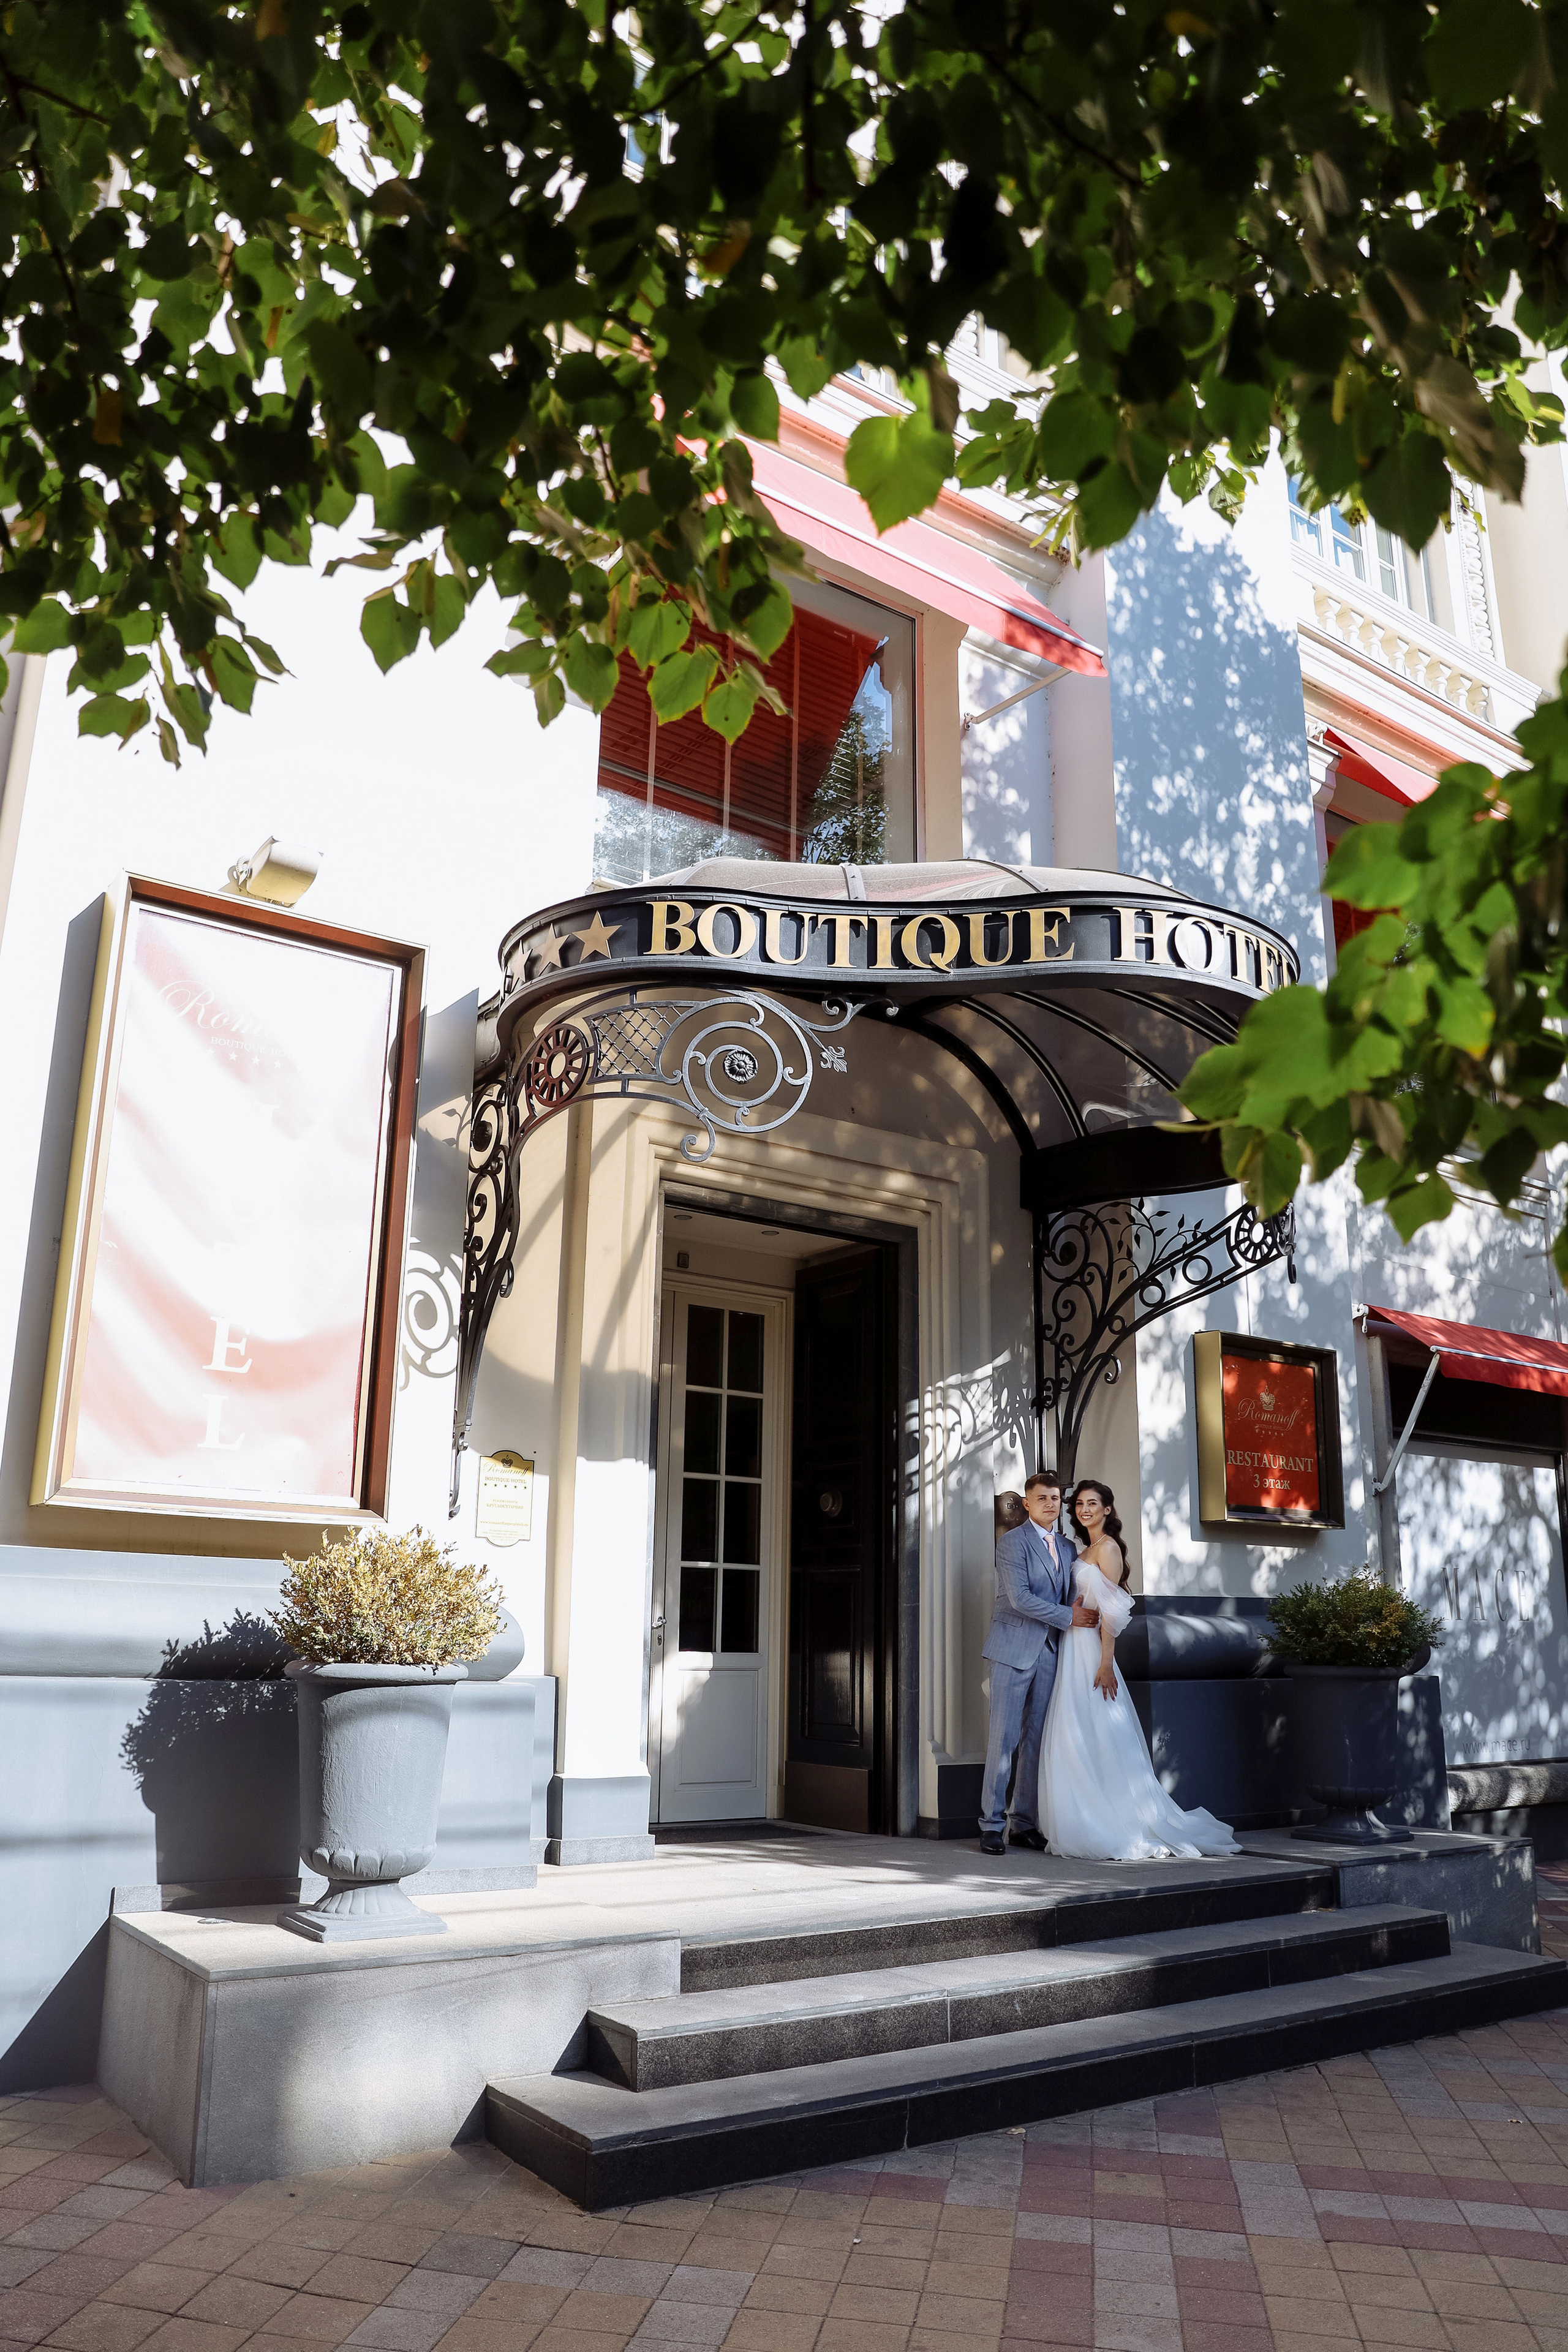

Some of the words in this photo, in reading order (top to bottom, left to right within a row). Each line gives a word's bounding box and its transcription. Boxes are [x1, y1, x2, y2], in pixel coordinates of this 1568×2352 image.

[644, 901, 1075, 974] BOUTIQUE
[211, 1036, 266, 1053] BOUTIQUE
[1238, 1398, 1300, 1431] Romanoff
[483, 1461, 531, 1478] Romanoff
[1227, 1450, 1314, 1472] RESTAURANT
[1253, 1474, 1261, 1488] 3
[1263, 1478, 1291, 1490] этаж
[1440, 1567, 1529, 1622] MACE
[1462, 1739, 1531, 1754] www.mace.ru
